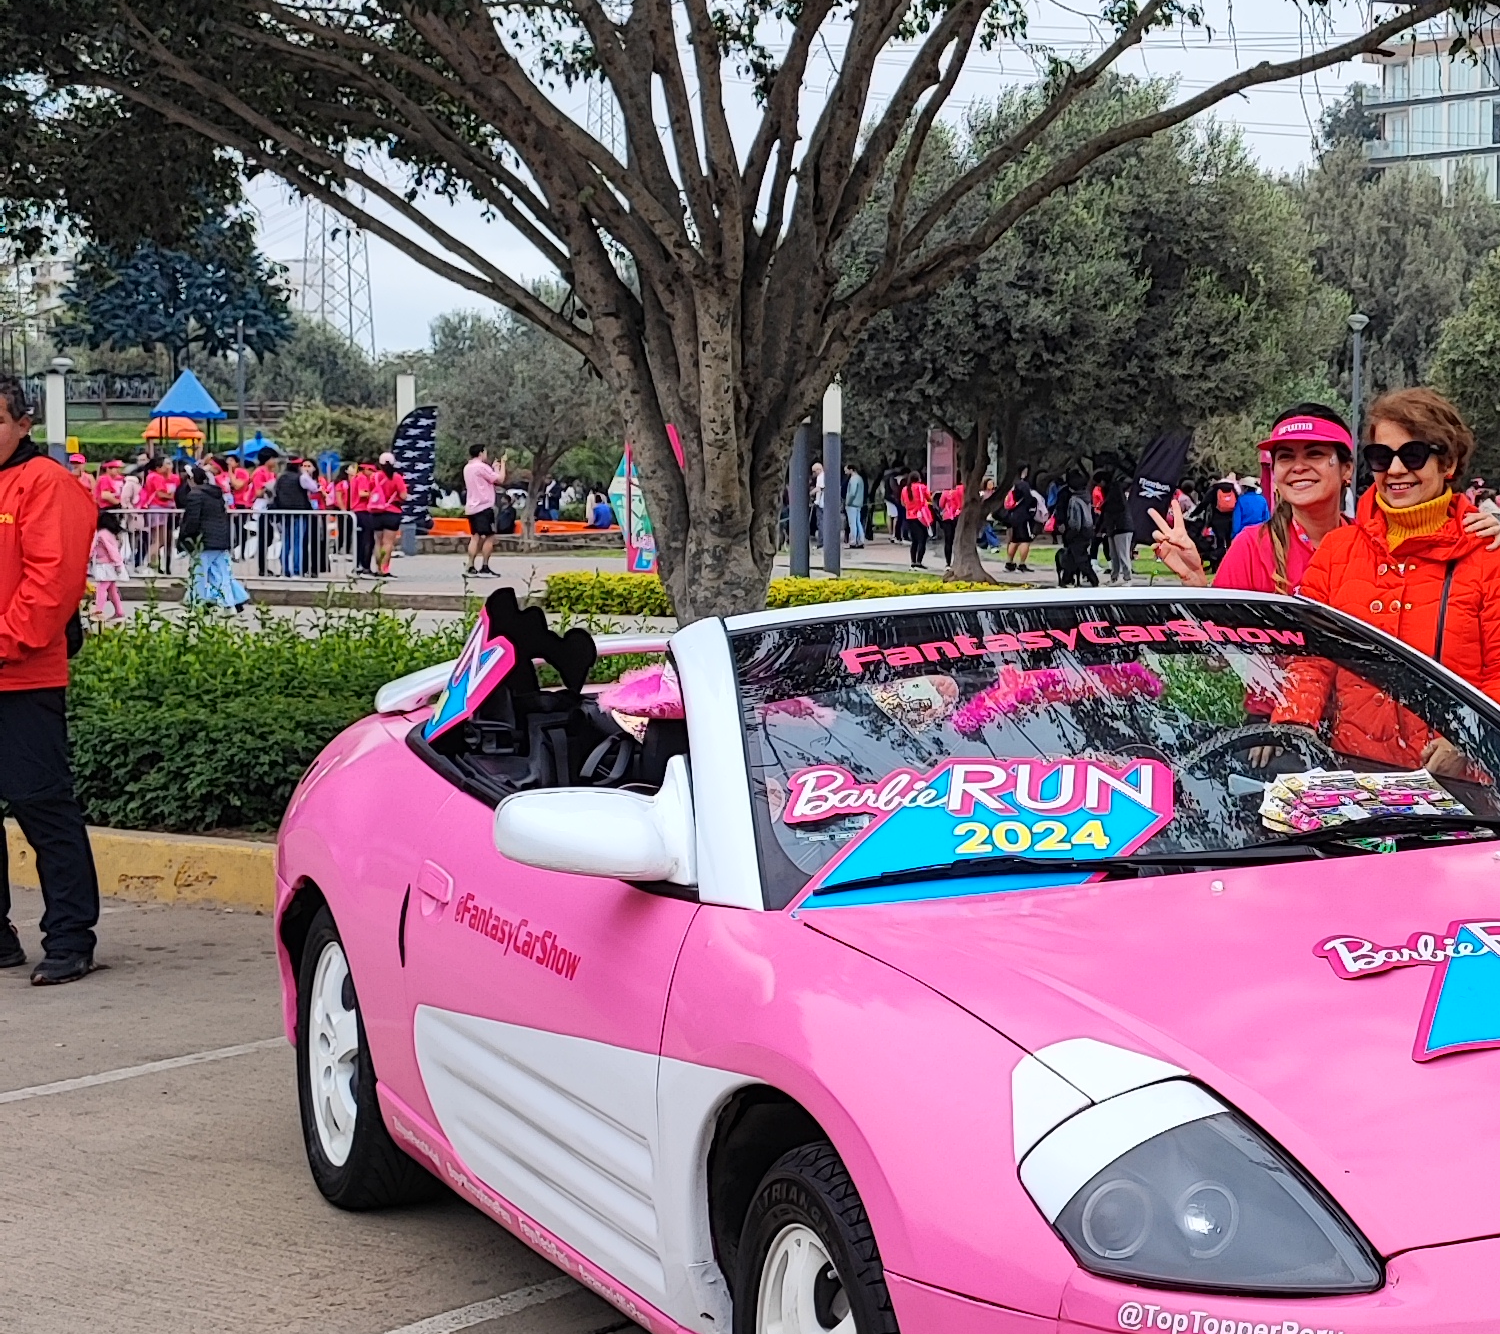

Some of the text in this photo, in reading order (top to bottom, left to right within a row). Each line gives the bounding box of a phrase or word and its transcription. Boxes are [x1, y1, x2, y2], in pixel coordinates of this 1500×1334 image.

[840, 620, 1306, 674] FantasyCarShow
[793, 764, 1154, 817] Barbie RUN
[953, 820, 1111, 855] 2024
[1325, 936, 1489, 972] Barbie
